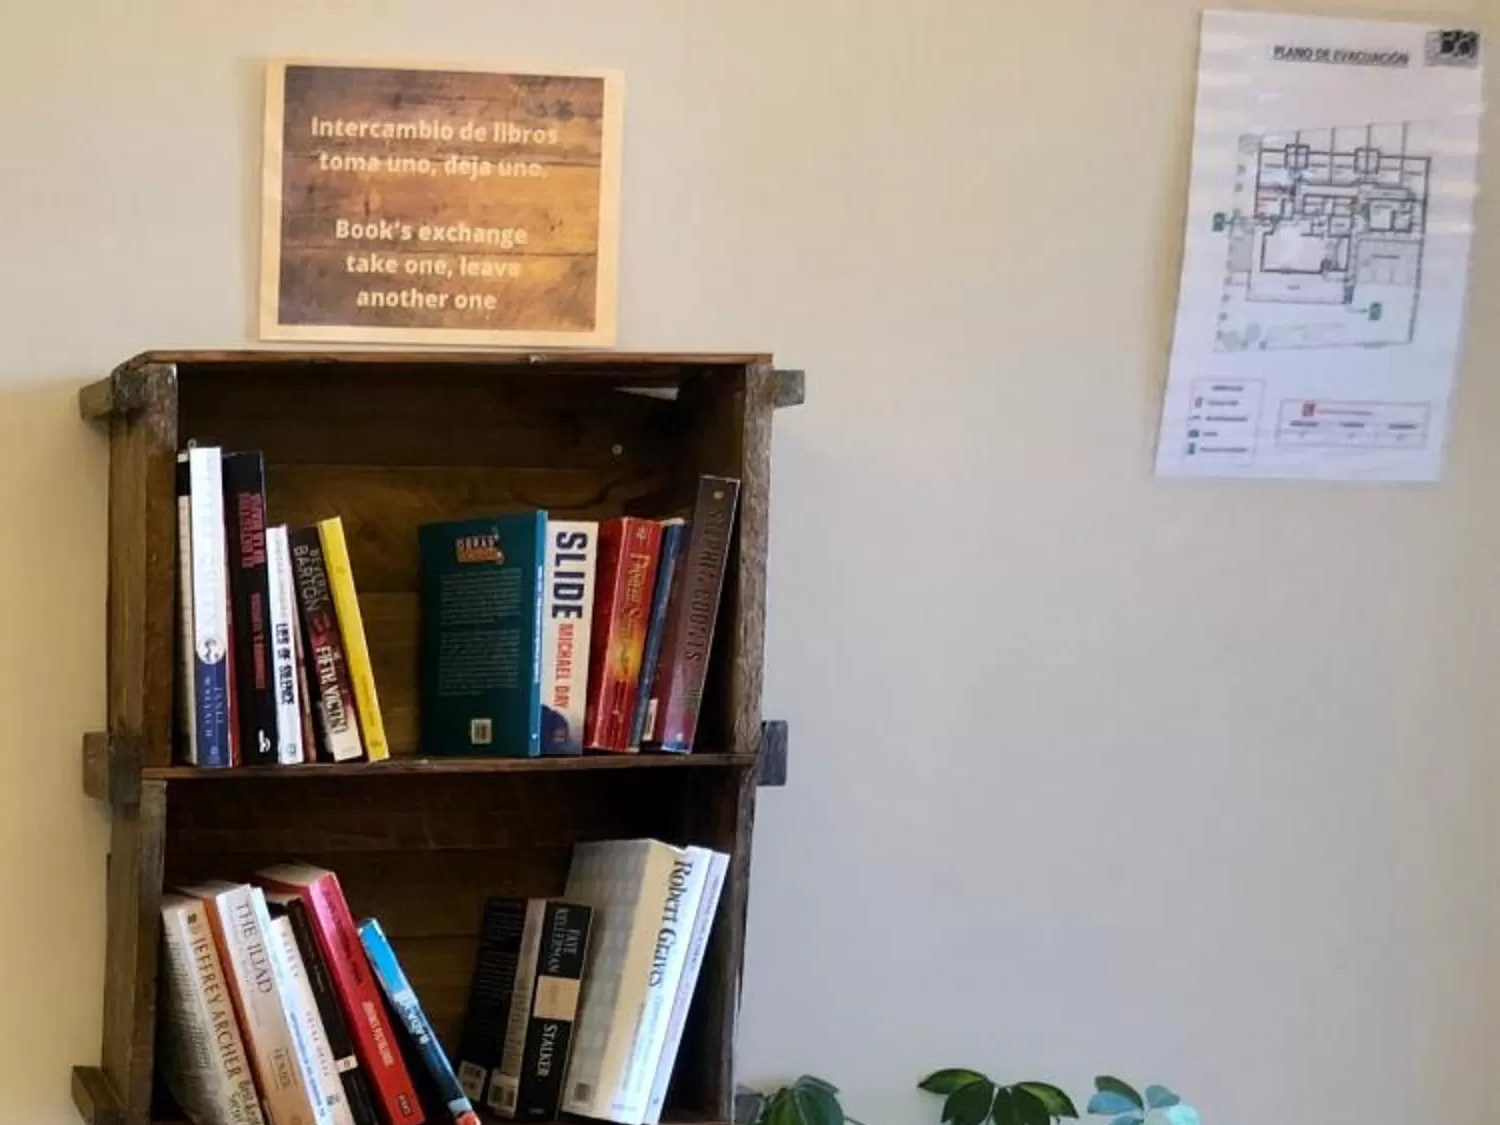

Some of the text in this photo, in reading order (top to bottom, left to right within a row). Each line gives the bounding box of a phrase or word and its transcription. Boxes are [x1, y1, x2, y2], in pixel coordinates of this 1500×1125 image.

[1273, 45, 1312, 61] PLANO
[1314, 48, 1330, 62] DE
[311, 116, 558, 145] Intercambio de libros
[320, 152, 380, 172] toma
[387, 156, 438, 177] uno,
[445, 155, 492, 181] deja
[335, 219, 528, 249] Book's exchange
[347, 255, 522, 279] take one, leave
[356, 288, 498, 310] another one
[293, 545, 321, 612] BARTON
[552, 531, 587, 619] SLIDE
[275, 623, 289, 648] LIES
[278, 660, 294, 705] SILENCE
[554, 624, 574, 708] MICHAEL DAY
[648, 860, 694, 987] Robert Graves
[236, 902, 273, 994] THE ILIAD
[190, 938, 242, 1080] JEFFREY ARCHER
[538, 1023, 558, 1077] STALKER
